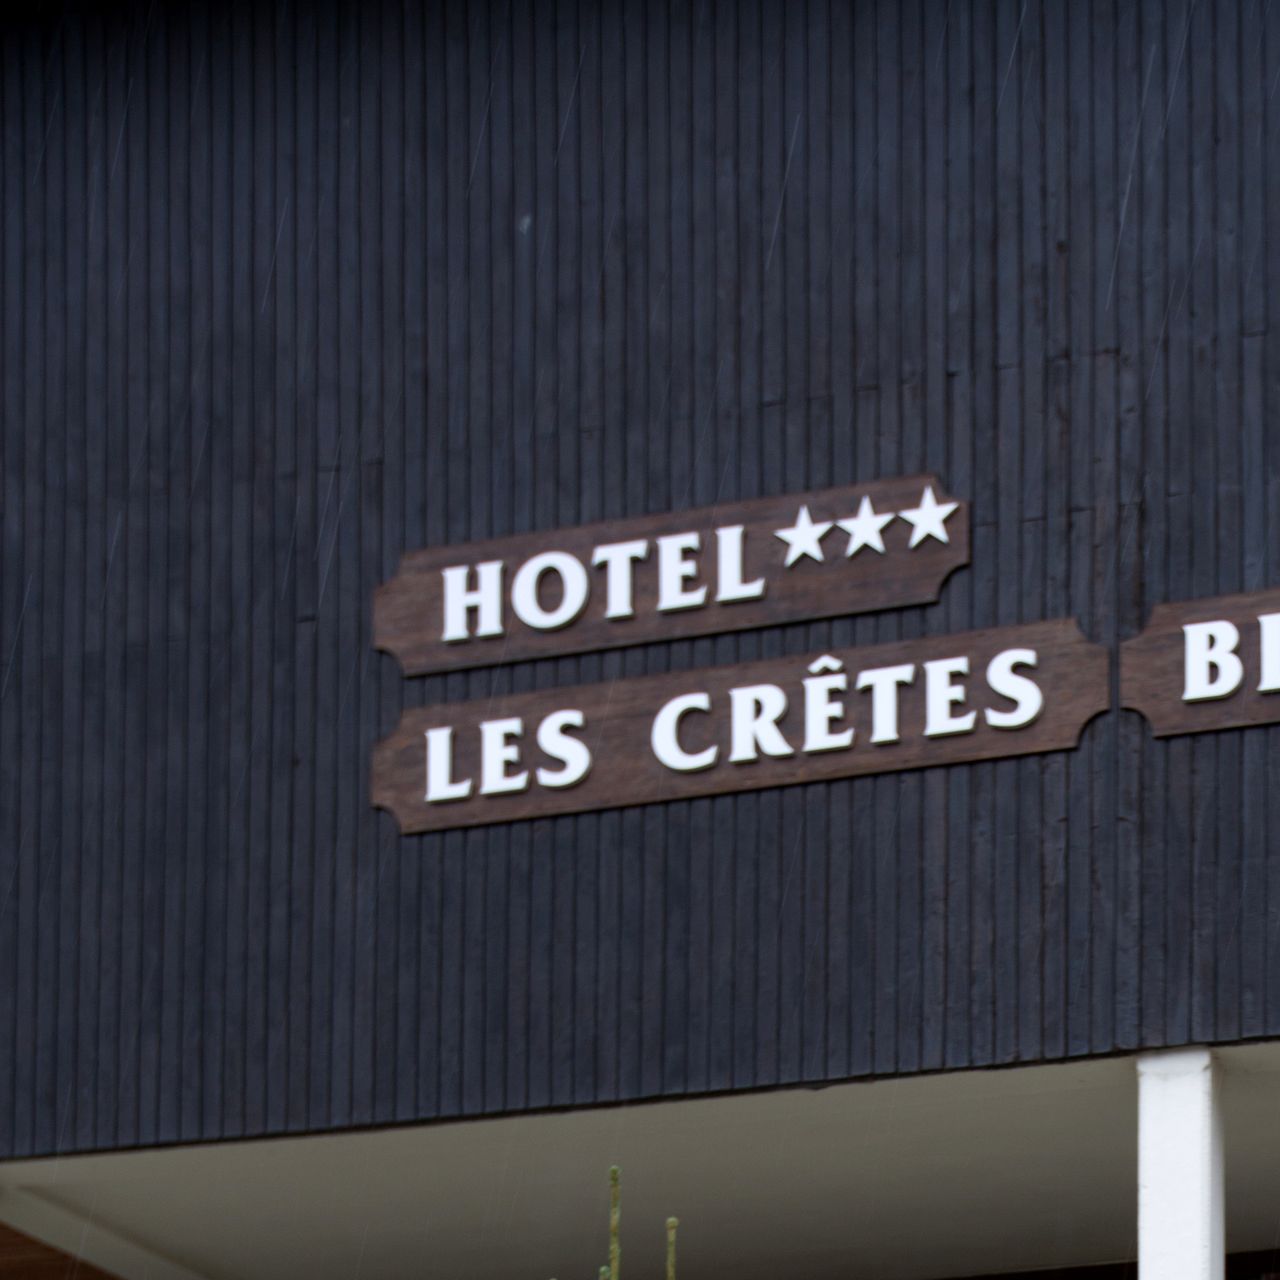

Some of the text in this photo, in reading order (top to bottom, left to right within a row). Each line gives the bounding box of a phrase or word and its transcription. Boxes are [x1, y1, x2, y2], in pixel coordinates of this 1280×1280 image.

[440, 524, 767, 643] HOTEL
[423, 647, 1045, 803] LES CRÊTES
